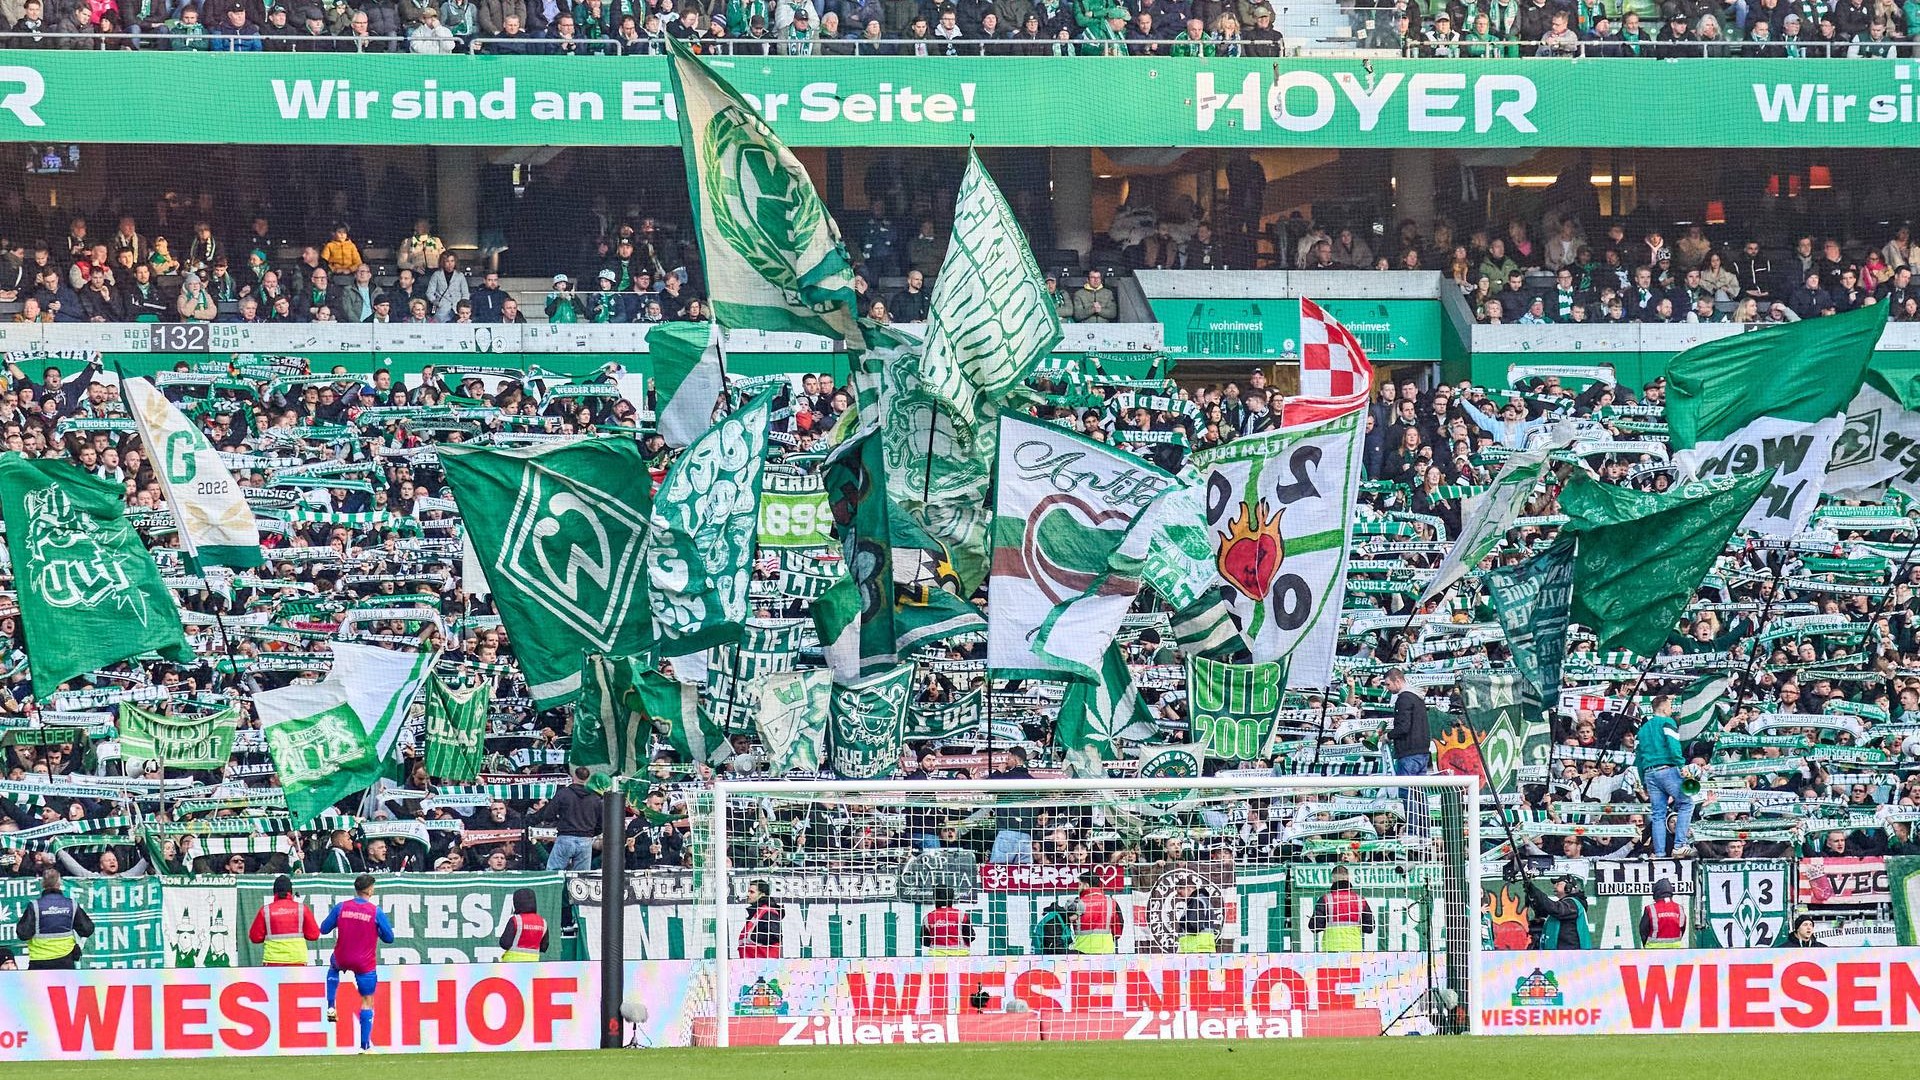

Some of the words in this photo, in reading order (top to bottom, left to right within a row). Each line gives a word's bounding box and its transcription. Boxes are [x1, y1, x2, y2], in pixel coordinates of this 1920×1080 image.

[271, 79, 379, 121] Wir
[391, 77, 516, 120] sind
[530, 91, 606, 121] an
[800, 82, 976, 123] Seite!
[1196, 72, 1539, 133] HOYER
[1752, 83, 1855, 123] Wir
[1869, 83, 1920, 123] si
[1209, 320, 1263, 331] wohninvest
[154, 327, 206, 351] 132
[1613, 405, 1665, 417] WERDER
[110, 420, 137, 429] BREME
[1123, 430, 1173, 443] WERDER
[198, 482, 229, 495] 2022
[933, 662, 984, 671] WESERS
[1195, 657, 1282, 715] UTB
[1720, 735, 1758, 745] WERDER
[1761, 734, 1799, 744] BREMEN
[229, 763, 273, 776] AVANTI
[77, 787, 120, 798] BREMEN
[922, 855, 948, 870] RIP
[1708, 863, 1735, 872] NIQUE
[1752, 863, 1785, 872] POLICE
[568, 876, 628, 901] OU
[732, 874, 898, 900] UBREAKAB
[901, 869, 972, 888] CIVETTA
[1721, 879, 1733, 905] 1
[1757, 878, 1773, 905] 3
[41, 908, 72, 916] SECURITY
[1755, 921, 1774, 947] 2
[1843, 926, 1868, 936] WERDER
[1871, 925, 1897, 935] BREME
[846, 968, 1361, 1017] WIESENHOF
[48, 976, 578, 1052] WIESENHOF
[1481, 1008, 1602, 1027] WIESENHOF
[777, 1014, 960, 1046] Zillertal
[1122, 1009, 1304, 1041] Zillertal
